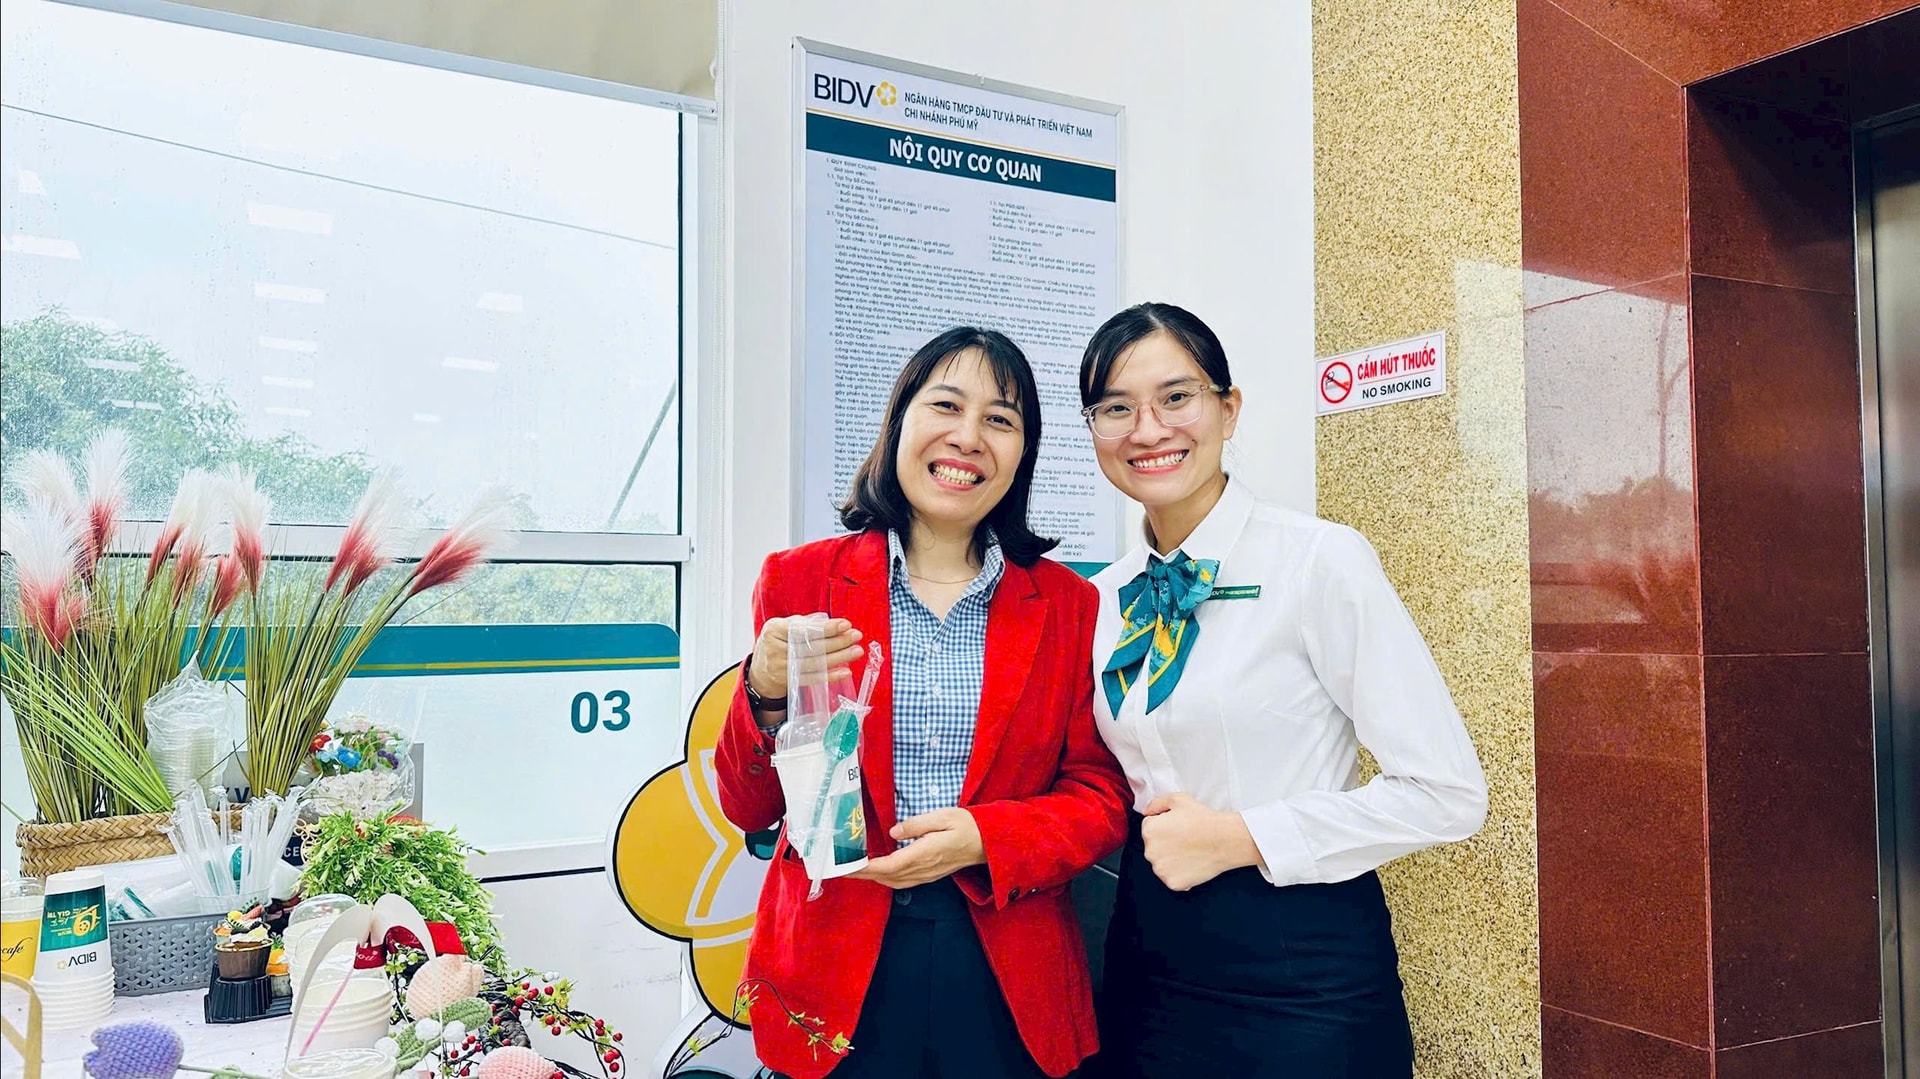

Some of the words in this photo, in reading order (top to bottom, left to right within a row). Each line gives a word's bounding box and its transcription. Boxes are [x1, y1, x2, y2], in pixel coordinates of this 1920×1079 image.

[814, 73, 876, 108] BIDV
[904, 92, 927, 105] NGÂN
[928, 96, 951, 111] HÀNG
[952, 102, 974, 115] TMCP
[992, 109, 1005, 121] TƯ
[1004, 111, 1015, 123] VÀ
[1016, 113, 1036, 127] PHÁT
[1059, 122, 1075, 136] VIỆT
[1076, 127, 1093, 138] NAM
[904, 107, 918, 119] CHI
[919, 109, 948, 126] NHÁNH
[949, 115, 965, 129] PHÚ
[966, 118, 979, 131] MỸ
[889, 135, 923, 164] NỘI
[927, 146, 964, 169] QUY
[967, 153, 993, 173] CƠ
[995, 158, 1042, 182] QUAN
[1357, 354, 1378, 381] CẤM
[1379, 352, 1400, 377] HÚT
[1402, 341, 1436, 372] THUỐC
[1362, 387, 1377, 400] NO
[1379, 377, 1431, 396] SMOKING
[571, 689, 631, 734] 03
[68, 951, 97, 967] BIDV
